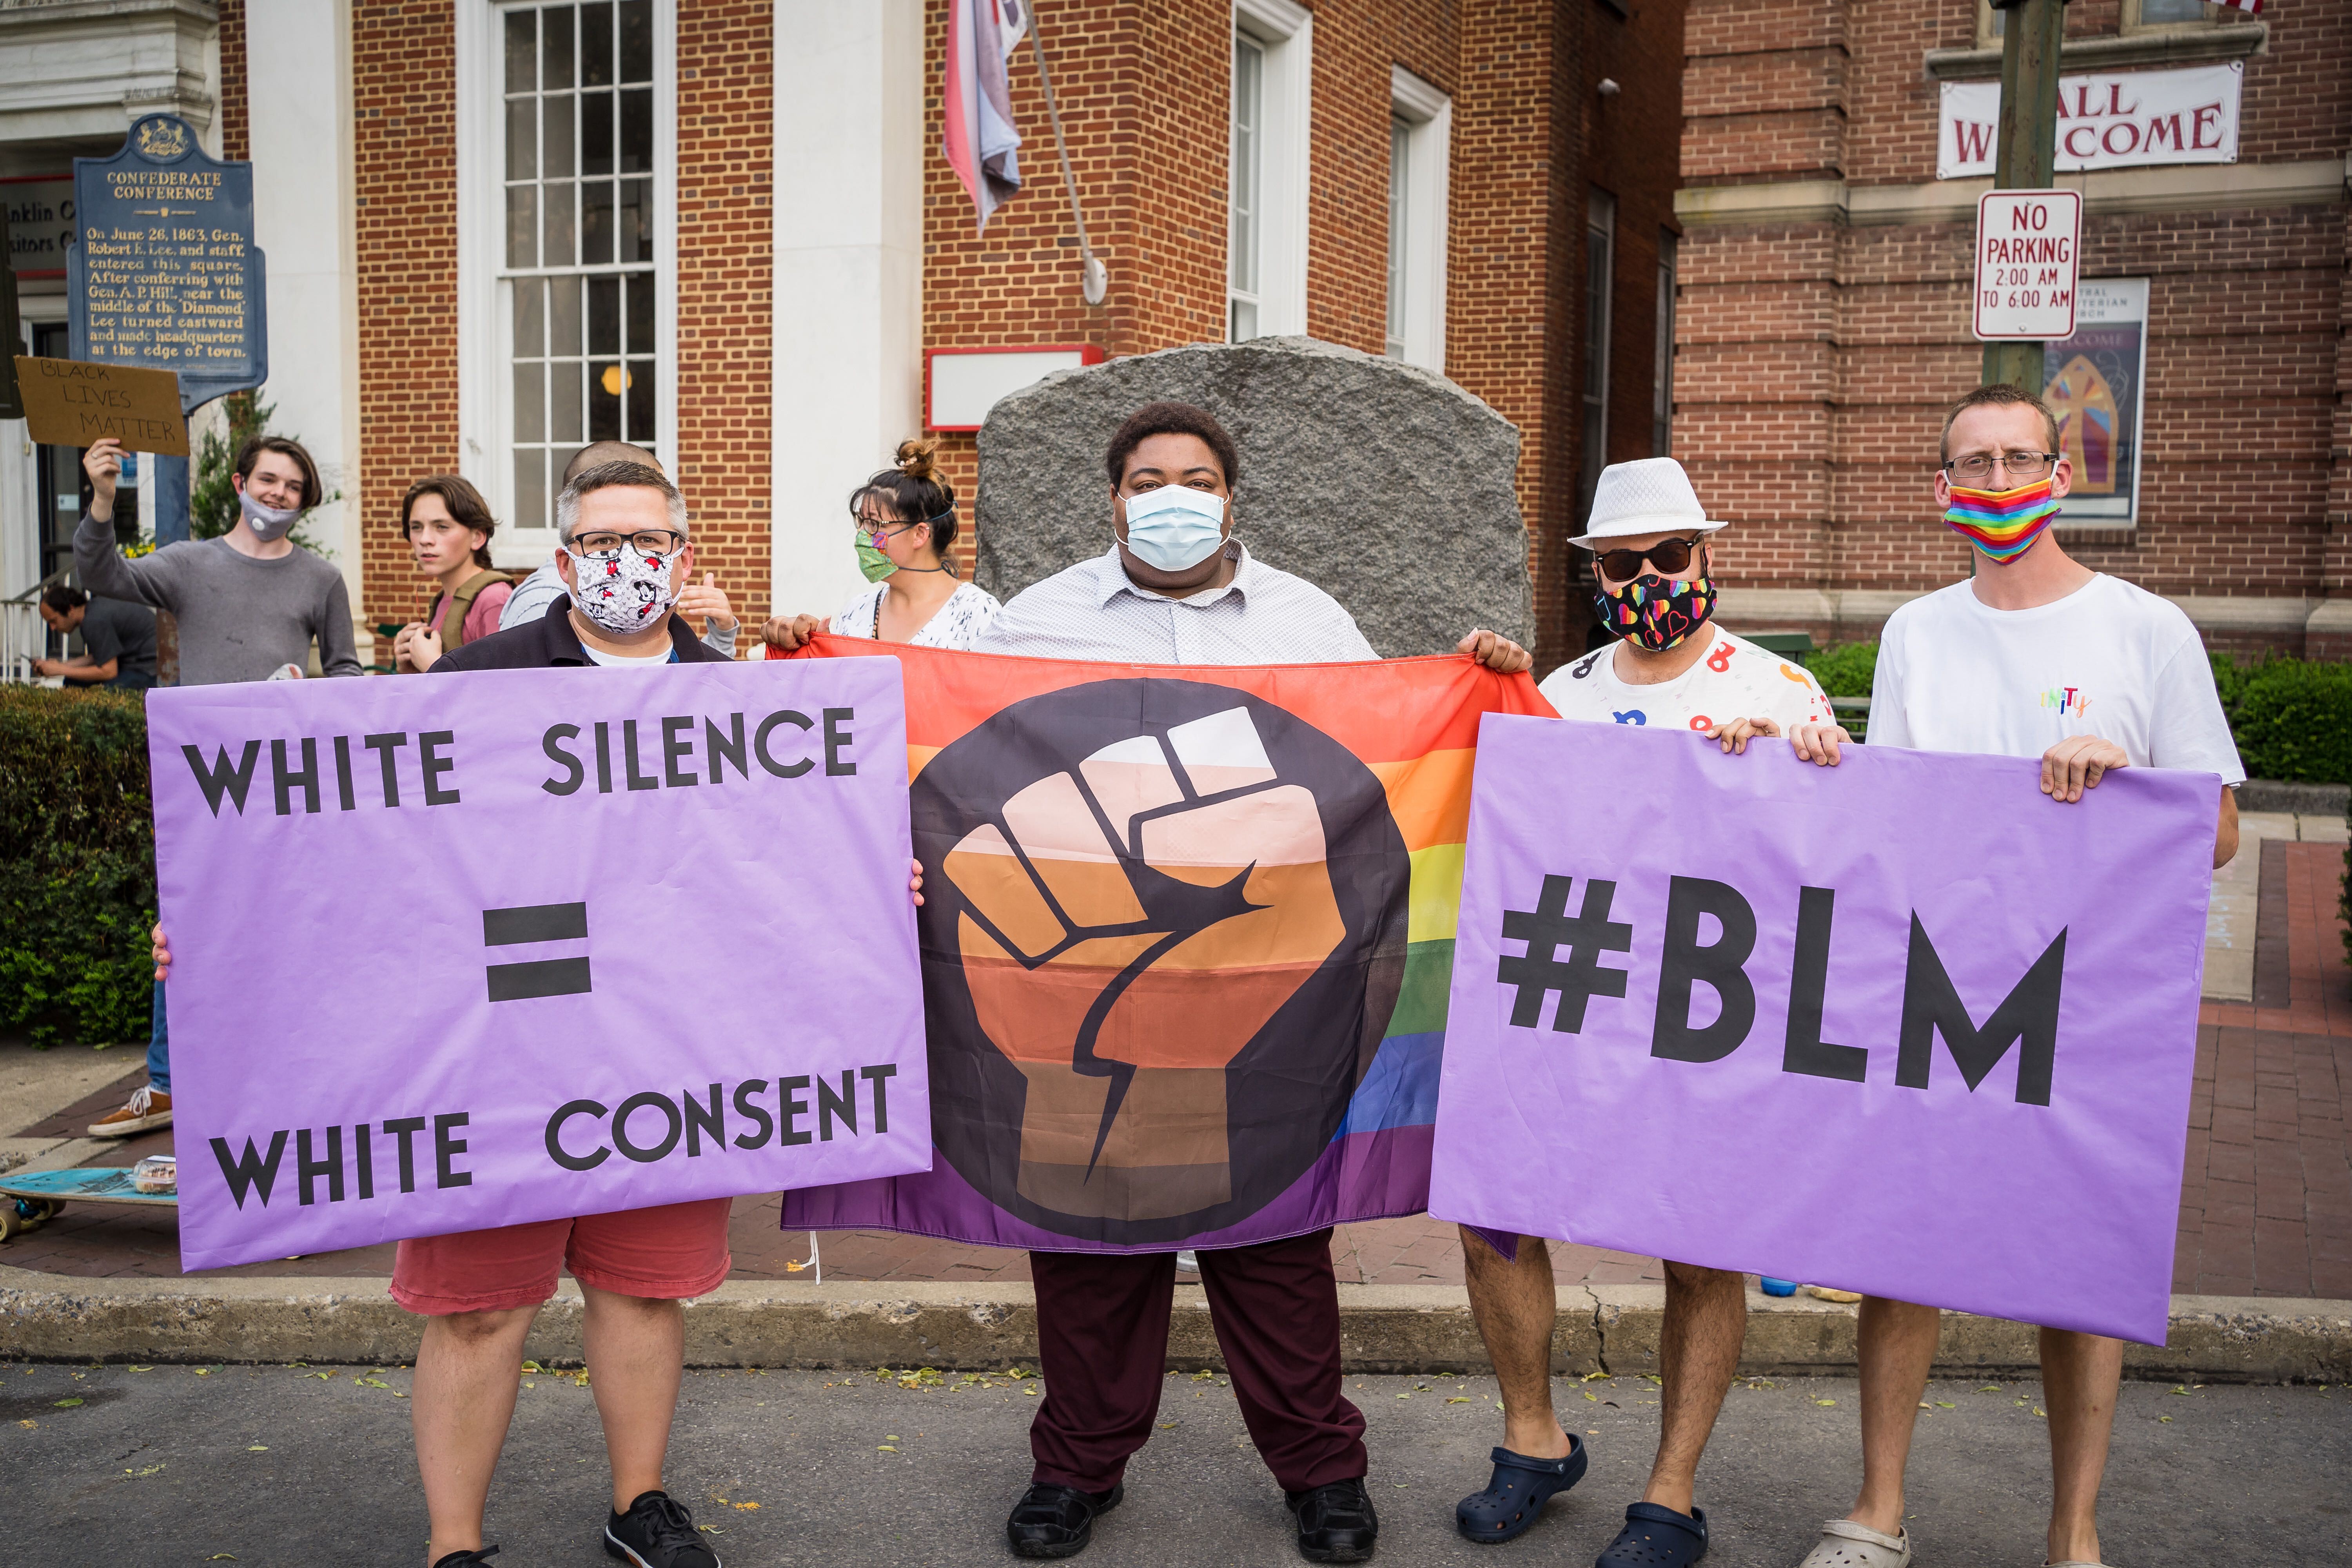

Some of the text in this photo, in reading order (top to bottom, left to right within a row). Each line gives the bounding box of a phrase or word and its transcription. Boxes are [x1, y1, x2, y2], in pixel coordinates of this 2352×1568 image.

[1954, 101, 2223, 162] WCOME
[107, 172, 221, 186] CONFEDERATE
[114, 187, 214, 201] CONFERENCE
[10, 202, 53, 222] nklin
[2013, 205, 2047, 231] NO
[9, 233, 54, 253] sitors
[87, 227, 105, 240] On
[111, 227, 144, 241] June
[212, 229, 244, 242] Gen.
[88, 241, 131, 255] Robert
[180, 244, 203, 257] and
[1987, 237, 2070, 263] PARKING
[89, 257, 144, 270] entered
[153, 258, 180, 271] this
[89, 271, 243, 288] After conferring with
[1996, 268, 2058, 287] 2:00 AM
[183, 289, 214, 300] near
[220, 287, 244, 300] the
[1983, 290, 2070, 308] TO 6:00 AM
[89, 300, 134, 313] middle
[137, 300, 153, 313] of
[156, 301, 177, 314] the
[91, 314, 243, 329] Lee turned eastward
[89, 329, 245, 346] and made headquarters
[92, 343, 247, 360] at the edge of town.
[40, 359, 110, 381] BLACK
[63, 385, 131, 408] LIVES
[80, 412, 176, 442] MATTER
[181, 708, 857, 818] WHITE SILENCE
[483, 902, 592, 1002] =
[1497, 874, 2067, 1107] #BLM
[209, 1063, 898, 1210] WHITE CONSENT
